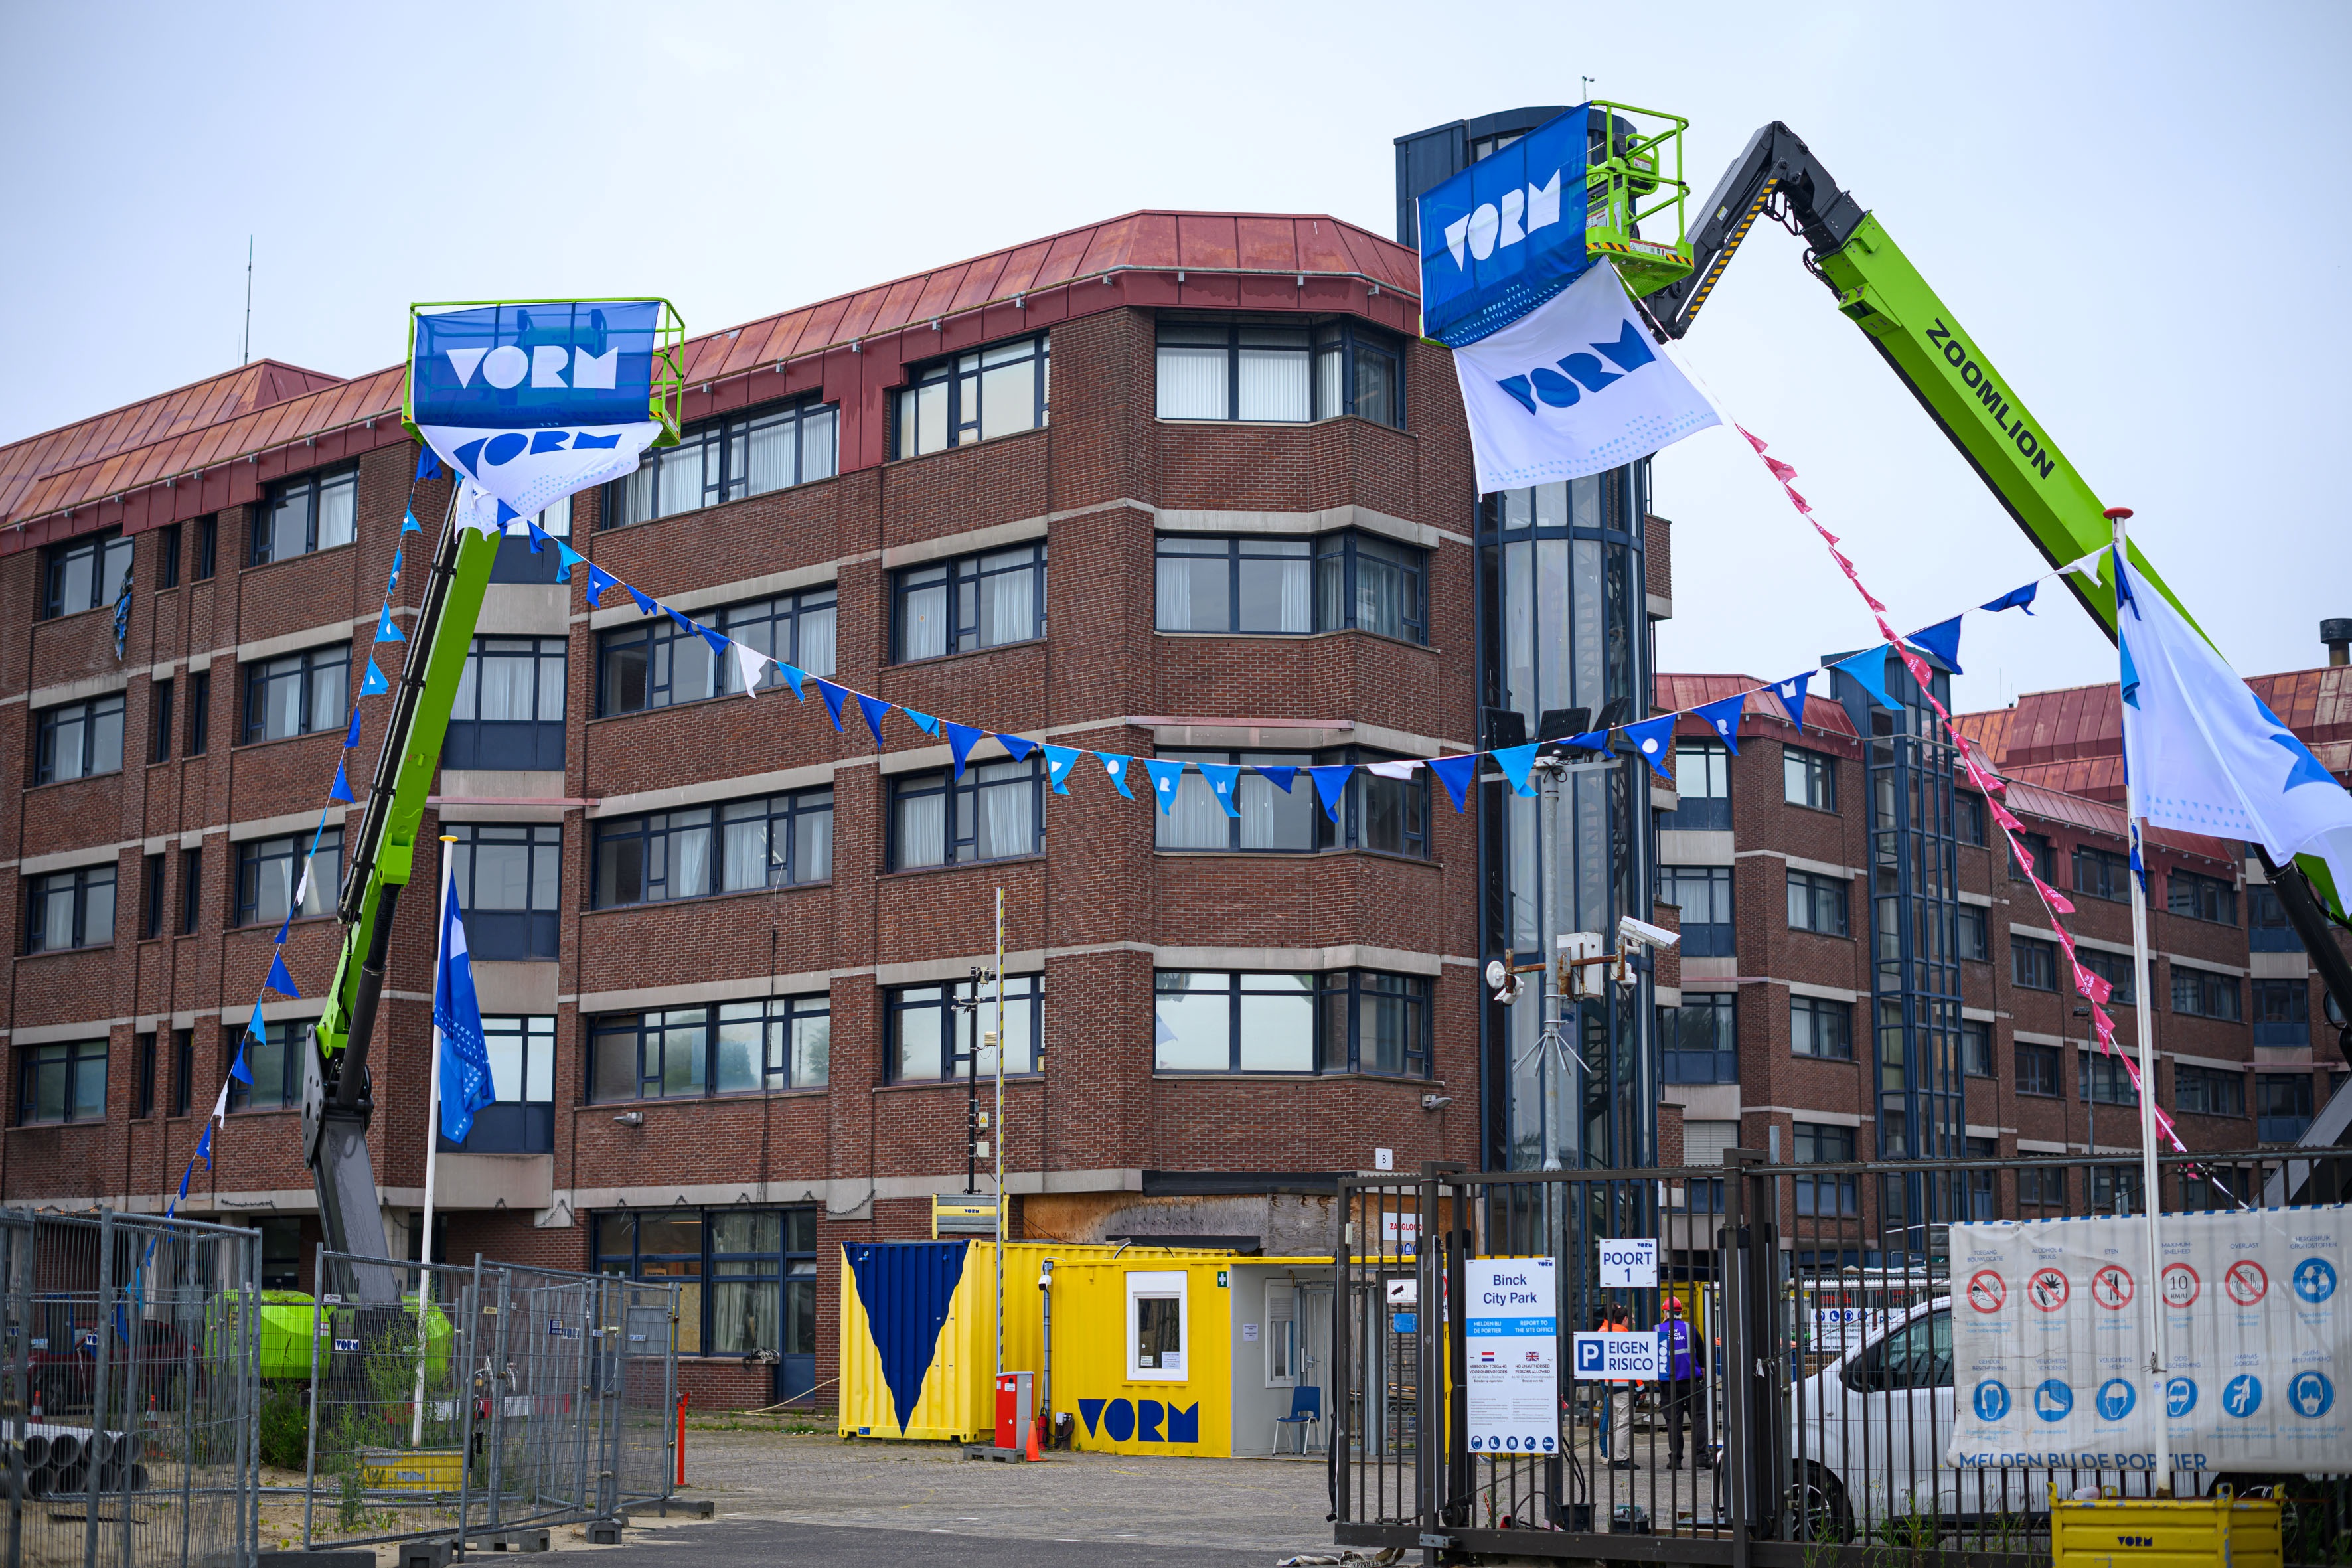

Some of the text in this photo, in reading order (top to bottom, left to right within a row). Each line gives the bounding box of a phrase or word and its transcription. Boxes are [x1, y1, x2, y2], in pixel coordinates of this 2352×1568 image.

[1444, 168, 1561, 272] VORM
[446, 345, 619, 390] VORM
[1496, 318, 1657, 416] VORM
[1926, 317, 2055, 480] ZOOMLION
[453, 431, 622, 480] VORM
[1382, 1154, 1387, 1164] B
[1603, 1252, 1652, 1265] POORT
[1493, 1274, 1527, 1286] Binck
[1624, 1267, 1630, 1282] 1
[2170, 1275, 2188, 1290] 10
[1484, 1292, 1537, 1306] City Park
[336, 1340, 359, 1350] VORM
[1609, 1341, 1648, 1354] EIGEN
[1583, 1344, 1599, 1368] P
[1609, 1358, 1653, 1371] RISICO
[1077, 1398, 1199, 1443] VORM
[1960, 1452, 2207, 1471] MELDEN BIJ DE PORIER
[2117, 1536, 2153, 1547] VORM
